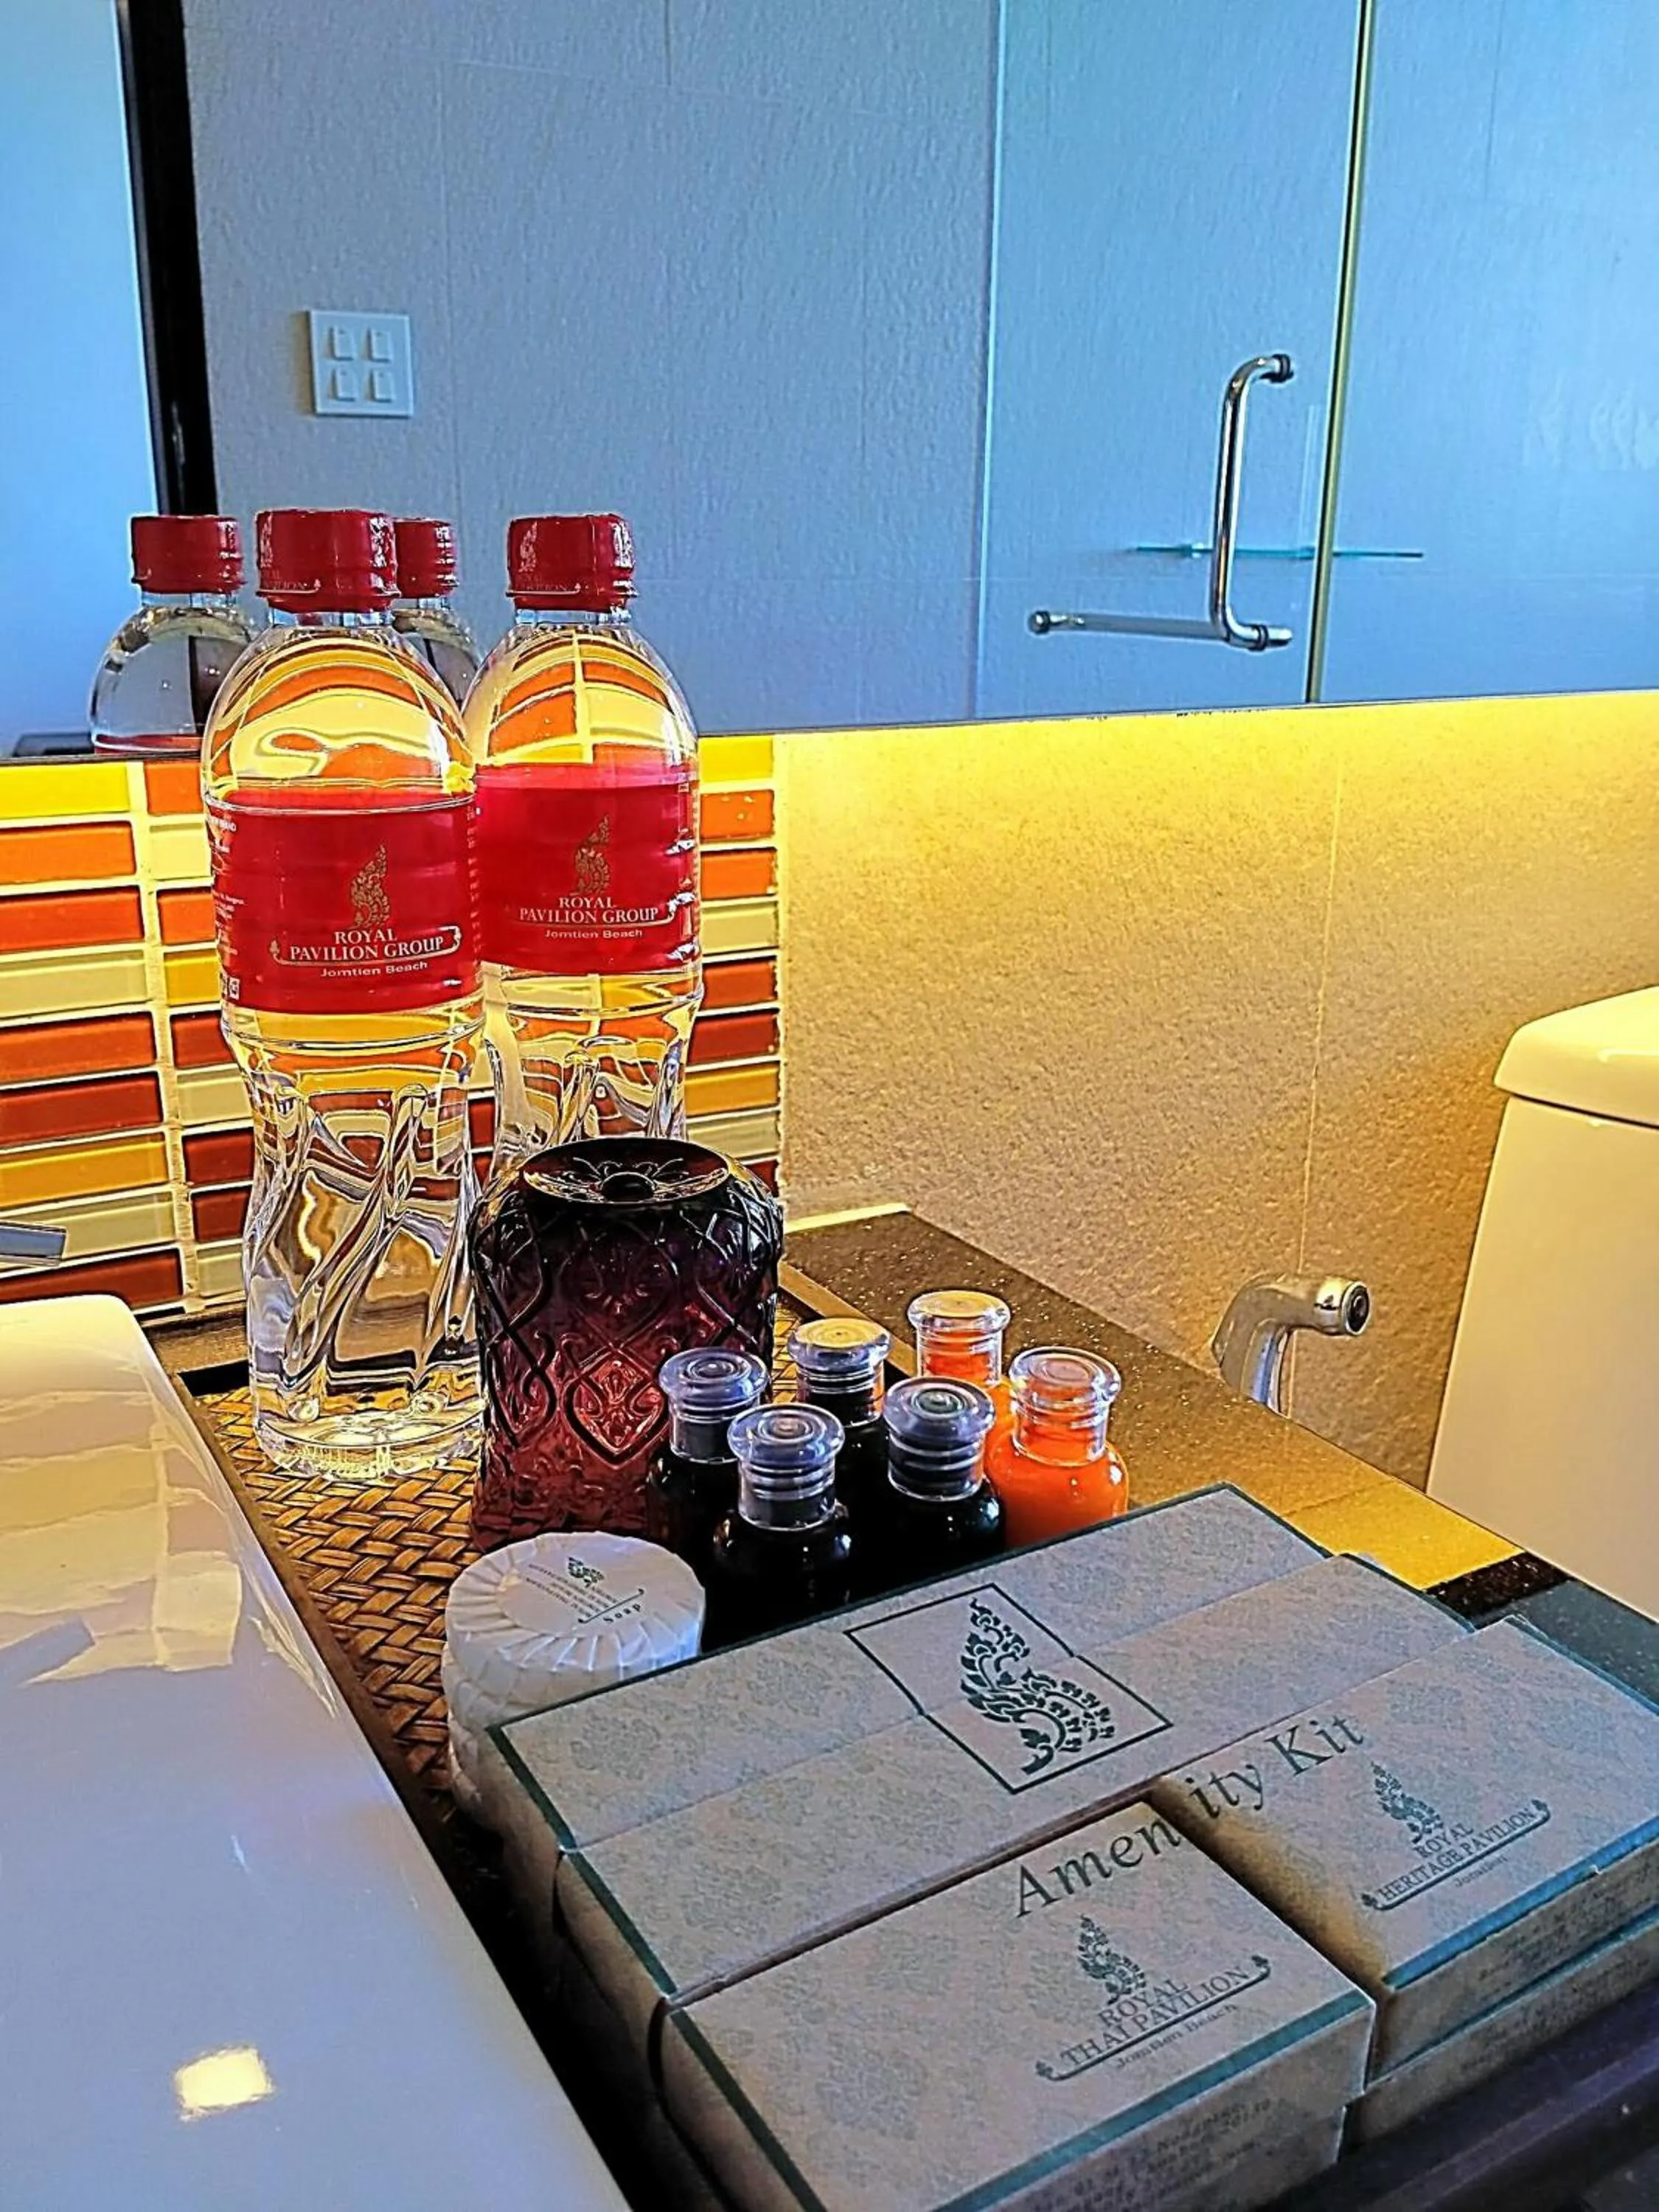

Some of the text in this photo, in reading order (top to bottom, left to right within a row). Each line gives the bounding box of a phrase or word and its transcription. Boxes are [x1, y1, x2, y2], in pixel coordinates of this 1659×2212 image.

[520, 907, 659, 923] PAVILION GROUP
[559, 897, 617, 908] ROYAL
[334, 928, 398, 945] ROYAL
[544, 929, 642, 939] Jomtien Beach
[290, 936, 445, 961] PAVILION GROUP
[320, 961, 428, 978] Jomtien Beach
[1264, 1715, 1364, 1777] Kit
[1413, 1823, 1474, 1858] ROYAL
[1377, 1807, 1537, 1900] HERITAGE PAVILION
[1060, 1965, 1250, 2065] THAI PAVILION
[1098, 1978, 1189, 2027] ROYAL
